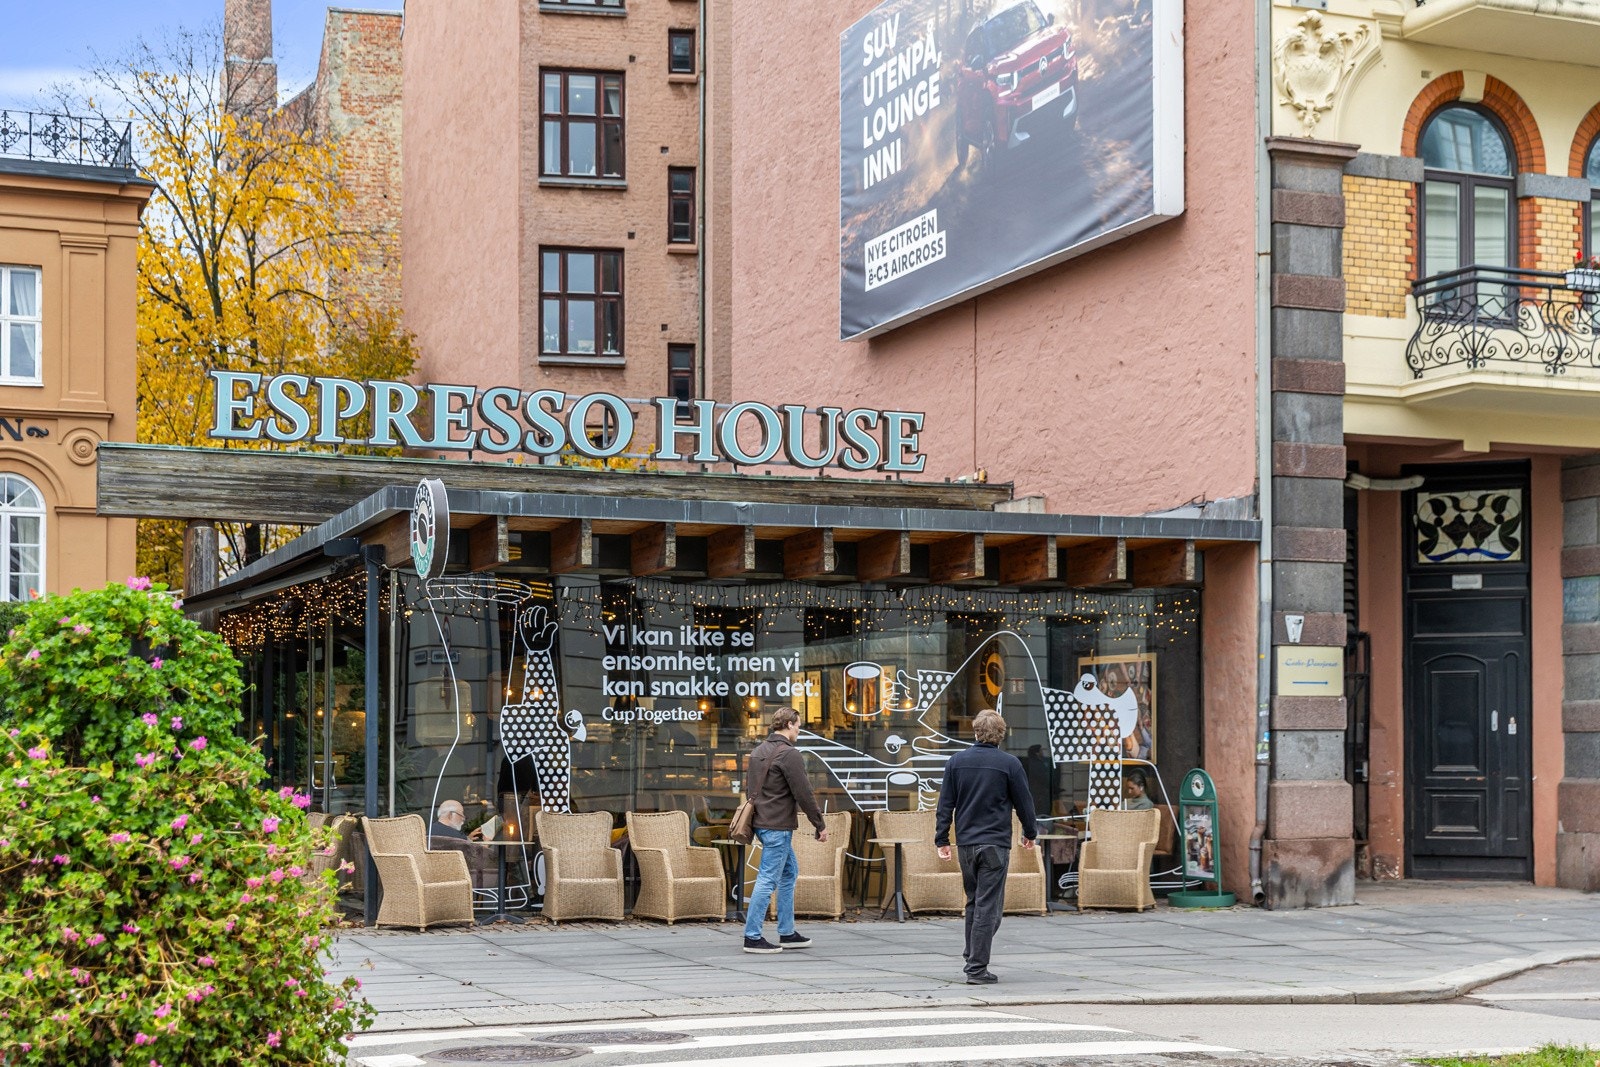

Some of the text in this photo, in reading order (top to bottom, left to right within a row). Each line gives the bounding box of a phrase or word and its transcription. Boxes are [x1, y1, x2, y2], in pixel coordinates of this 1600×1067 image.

[863, 12, 900, 67] SUV
[863, 17, 942, 107] UTENPÅ,
[863, 71, 941, 149] LOUNGE
[863, 138, 902, 190] INNI
[867, 215, 935, 264] NYE CITROËN
[891, 237, 944, 277] AIRCROSS
[208, 369, 928, 473] ESPRESSO HOUSE
[602, 624, 755, 647] Vi kan ikke se
[602, 650, 800, 674] ensomhet, men vi
[602, 675, 820, 697] kan snakke om det.
